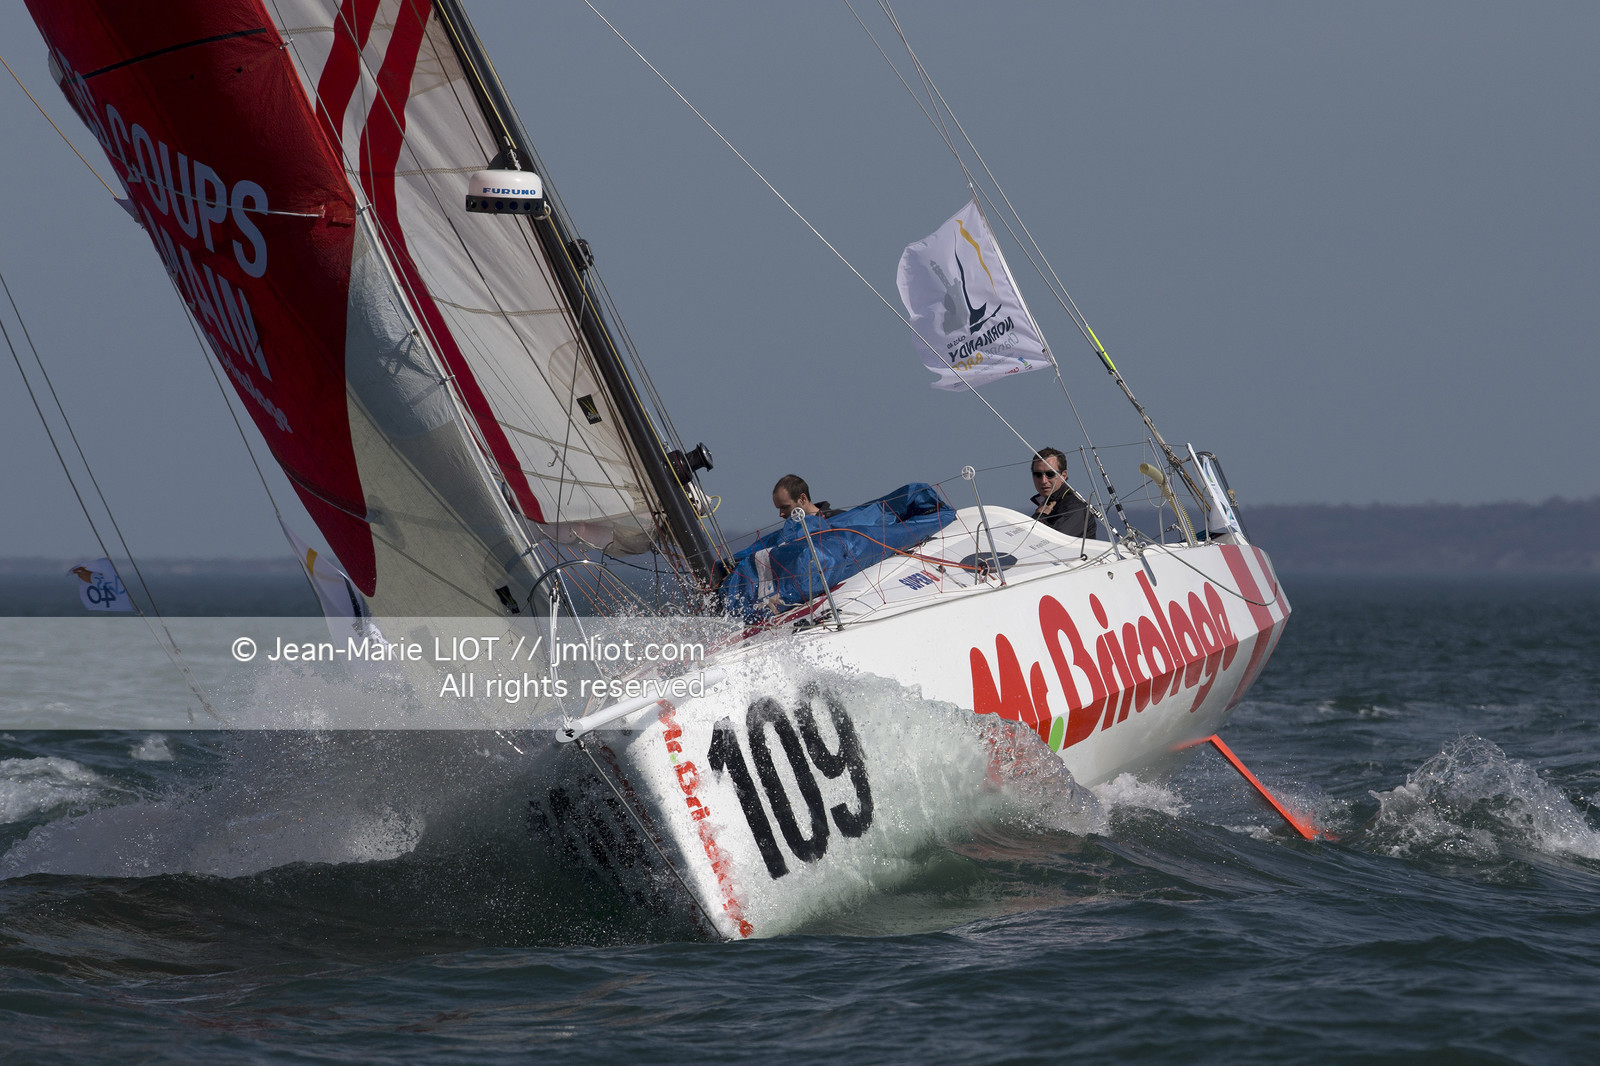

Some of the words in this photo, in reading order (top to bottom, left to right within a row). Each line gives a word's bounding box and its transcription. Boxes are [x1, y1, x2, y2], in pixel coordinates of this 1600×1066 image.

[106, 103, 269, 279] COUPS
[482, 187, 536, 196] FURUNO
[707, 678, 874, 881] 109
